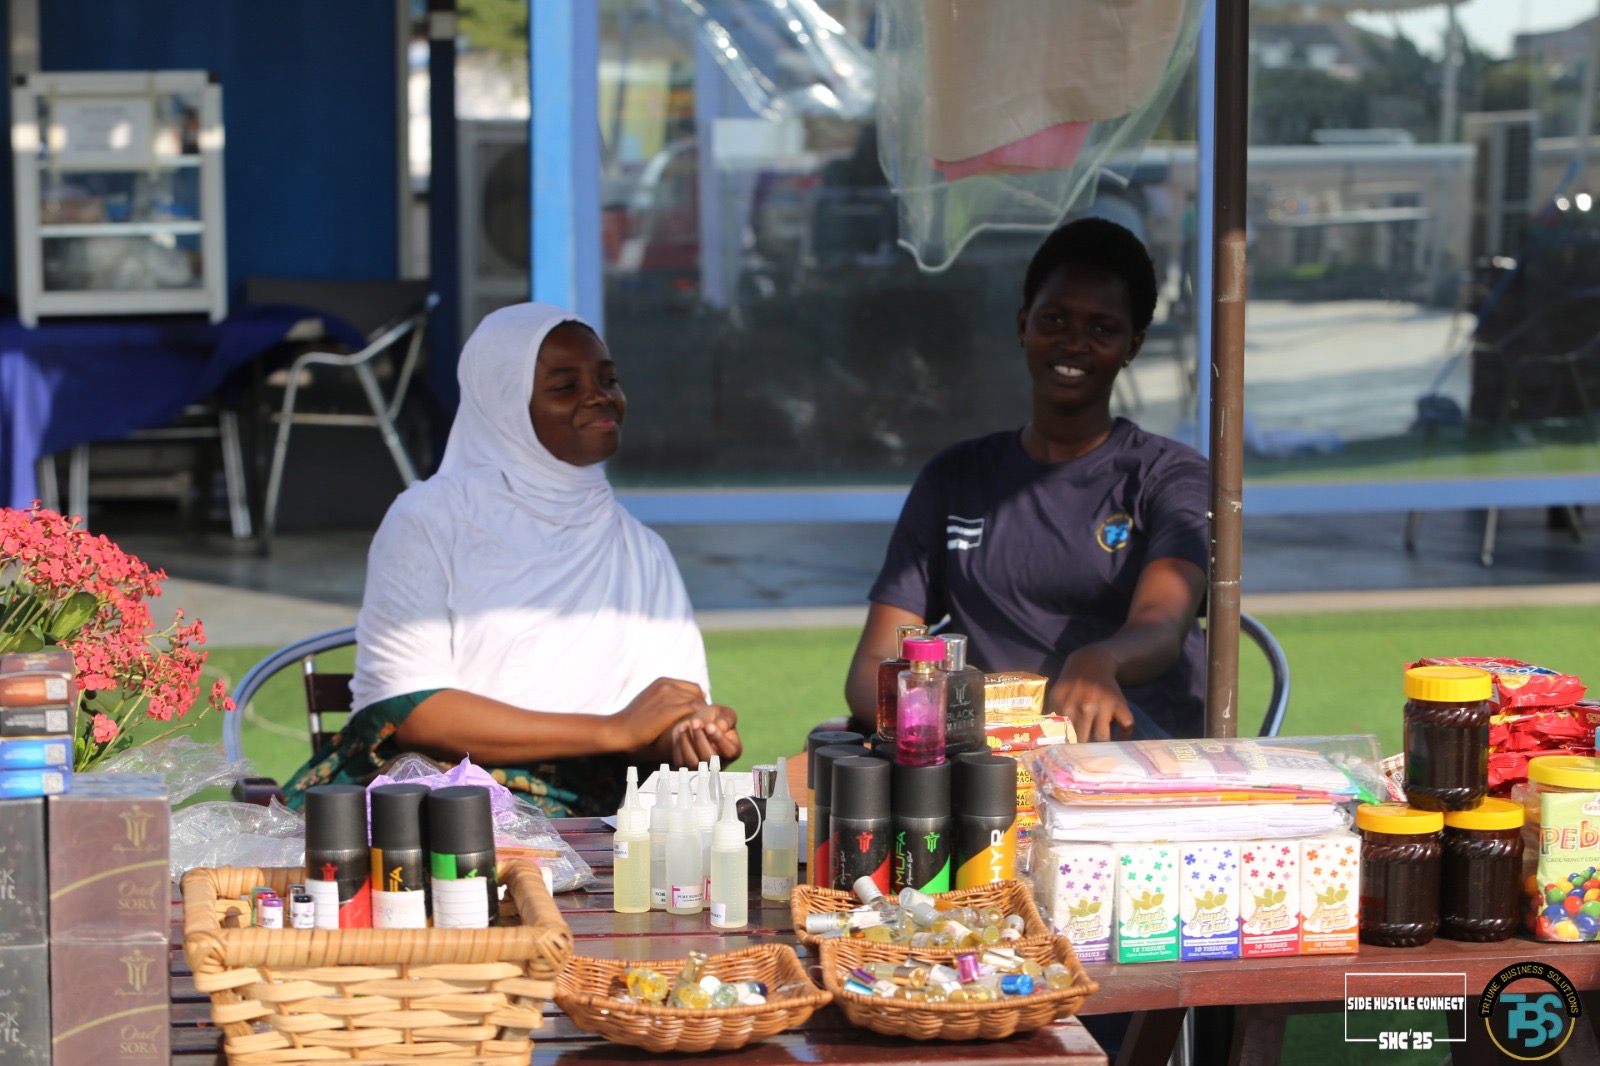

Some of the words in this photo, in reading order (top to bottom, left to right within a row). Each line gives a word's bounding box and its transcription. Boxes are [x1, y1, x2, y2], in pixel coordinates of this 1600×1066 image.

[895, 831, 906, 885] MUFA
[118, 880, 161, 898] Oud
[118, 898, 157, 910] SORA
[1264, 941, 1288, 949] TISSUES
[120, 1023, 163, 1042] Oud
[120, 1042, 158, 1055] SORA
